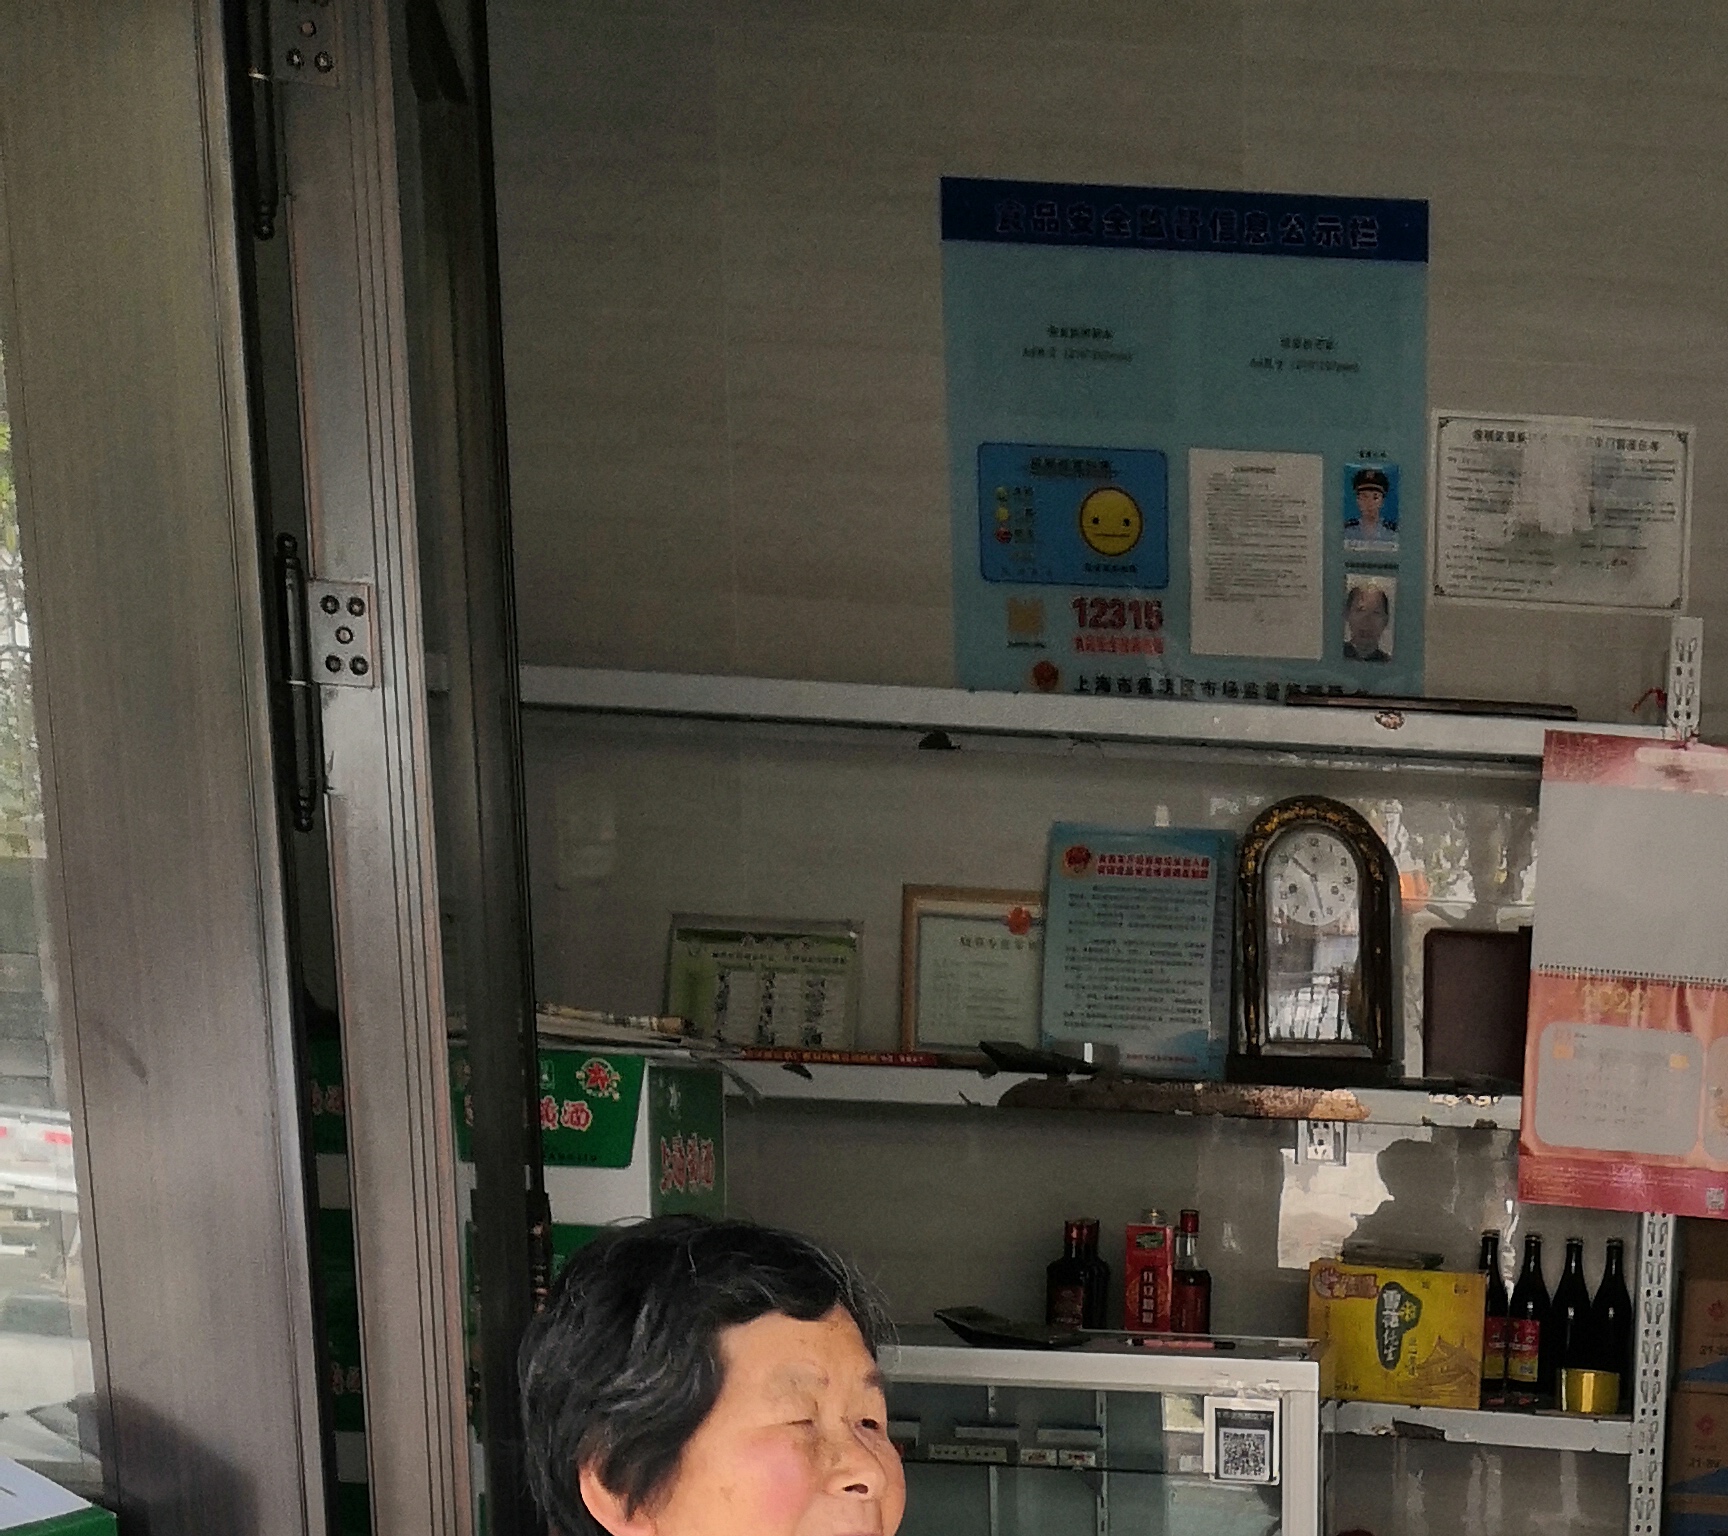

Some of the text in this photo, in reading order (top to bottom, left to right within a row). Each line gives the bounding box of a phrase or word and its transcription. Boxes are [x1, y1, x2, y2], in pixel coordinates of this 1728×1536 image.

[996, 201, 1379, 249] 食品安全监督信息公示栏
[1072, 597, 1163, 632] 12315
